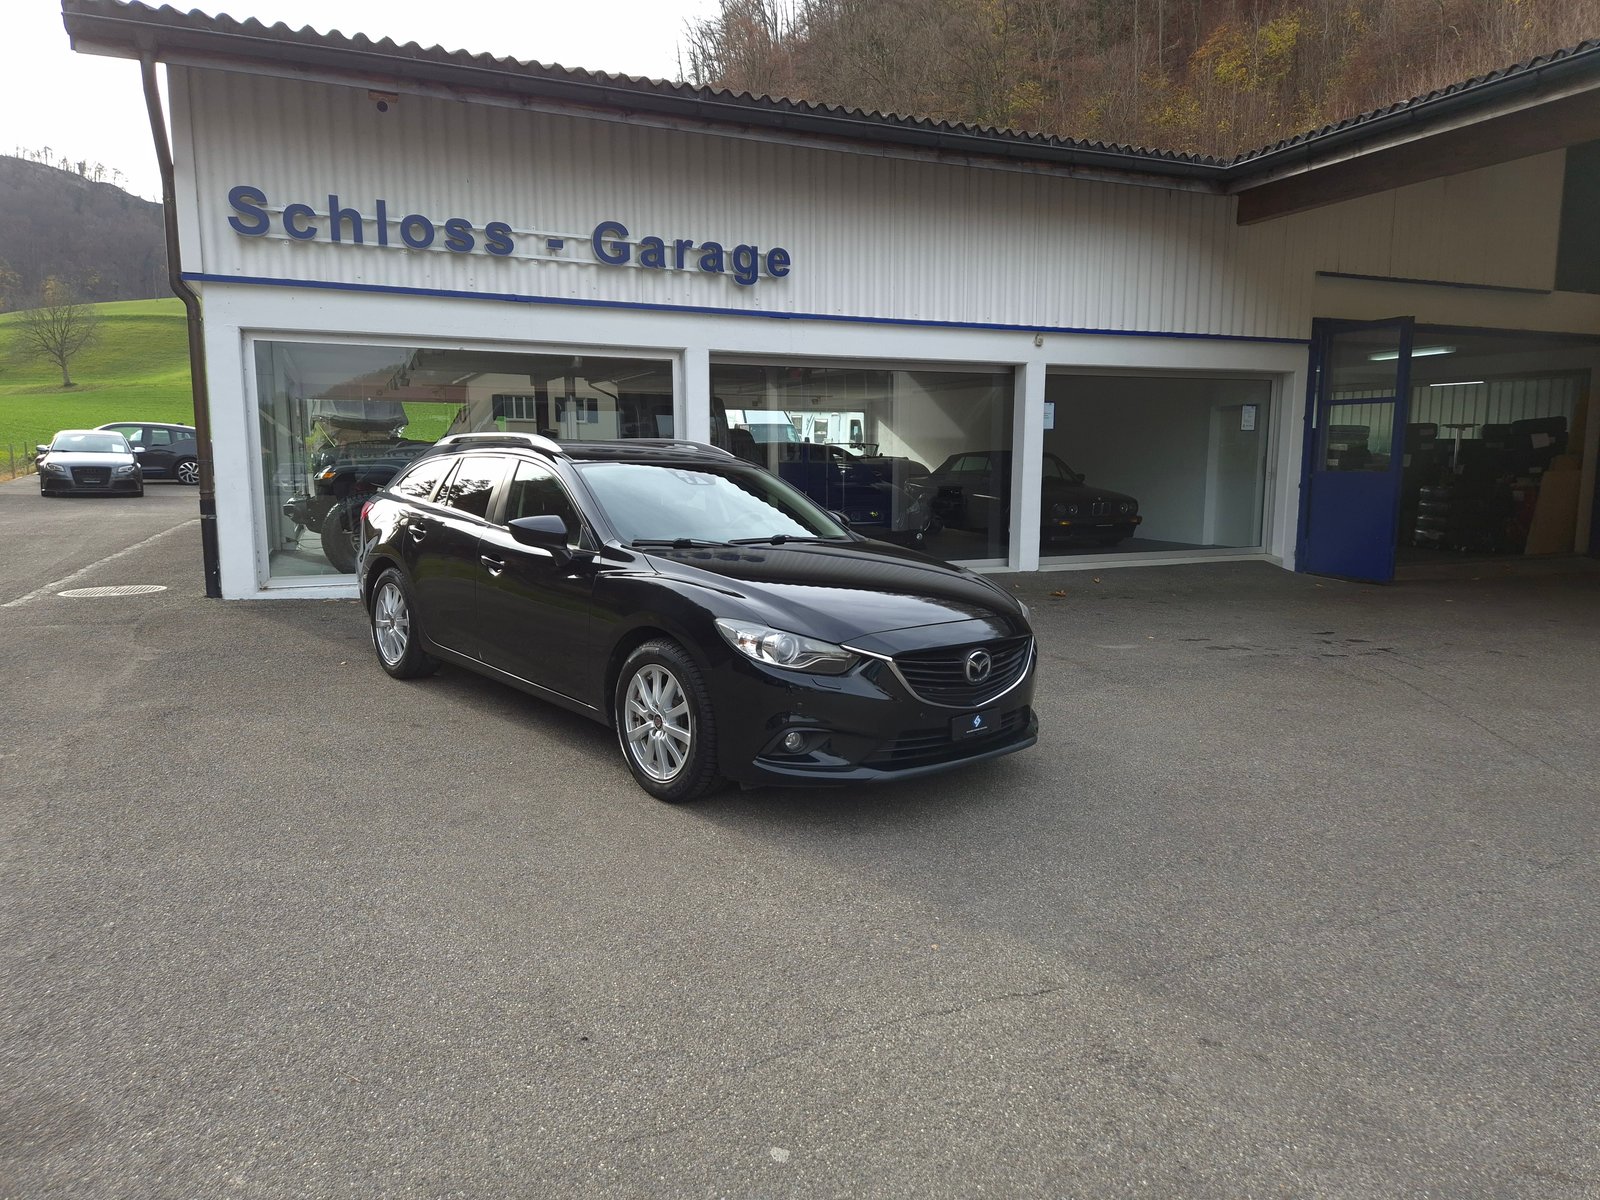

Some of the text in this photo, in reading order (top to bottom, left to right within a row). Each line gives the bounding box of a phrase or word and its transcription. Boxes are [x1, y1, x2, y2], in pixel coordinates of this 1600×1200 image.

[227, 185, 792, 286] Schloss - Garage
